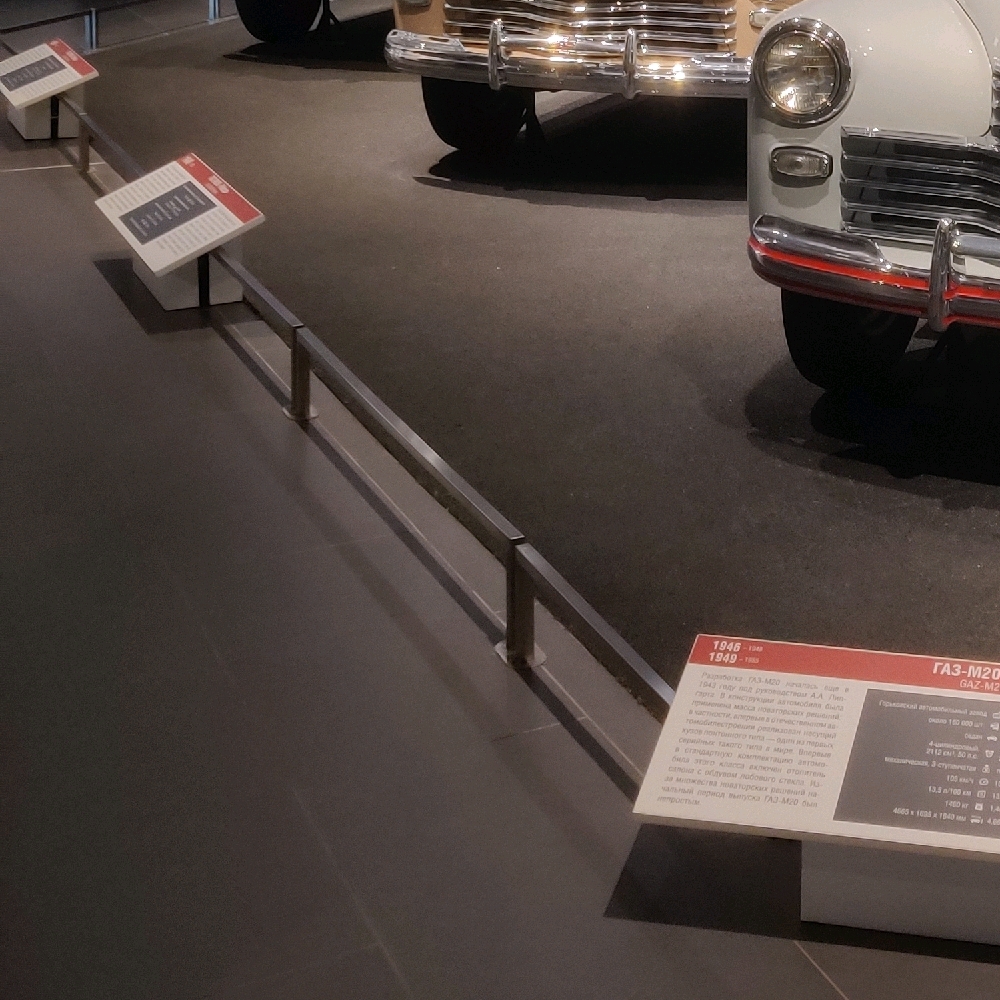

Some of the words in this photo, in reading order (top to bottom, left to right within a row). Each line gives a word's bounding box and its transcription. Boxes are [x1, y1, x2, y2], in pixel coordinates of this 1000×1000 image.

[711, 640, 741, 652] 1946
[707, 651, 737, 663] 1949
[932, 661, 1000, 680] ГАЗ-М20
